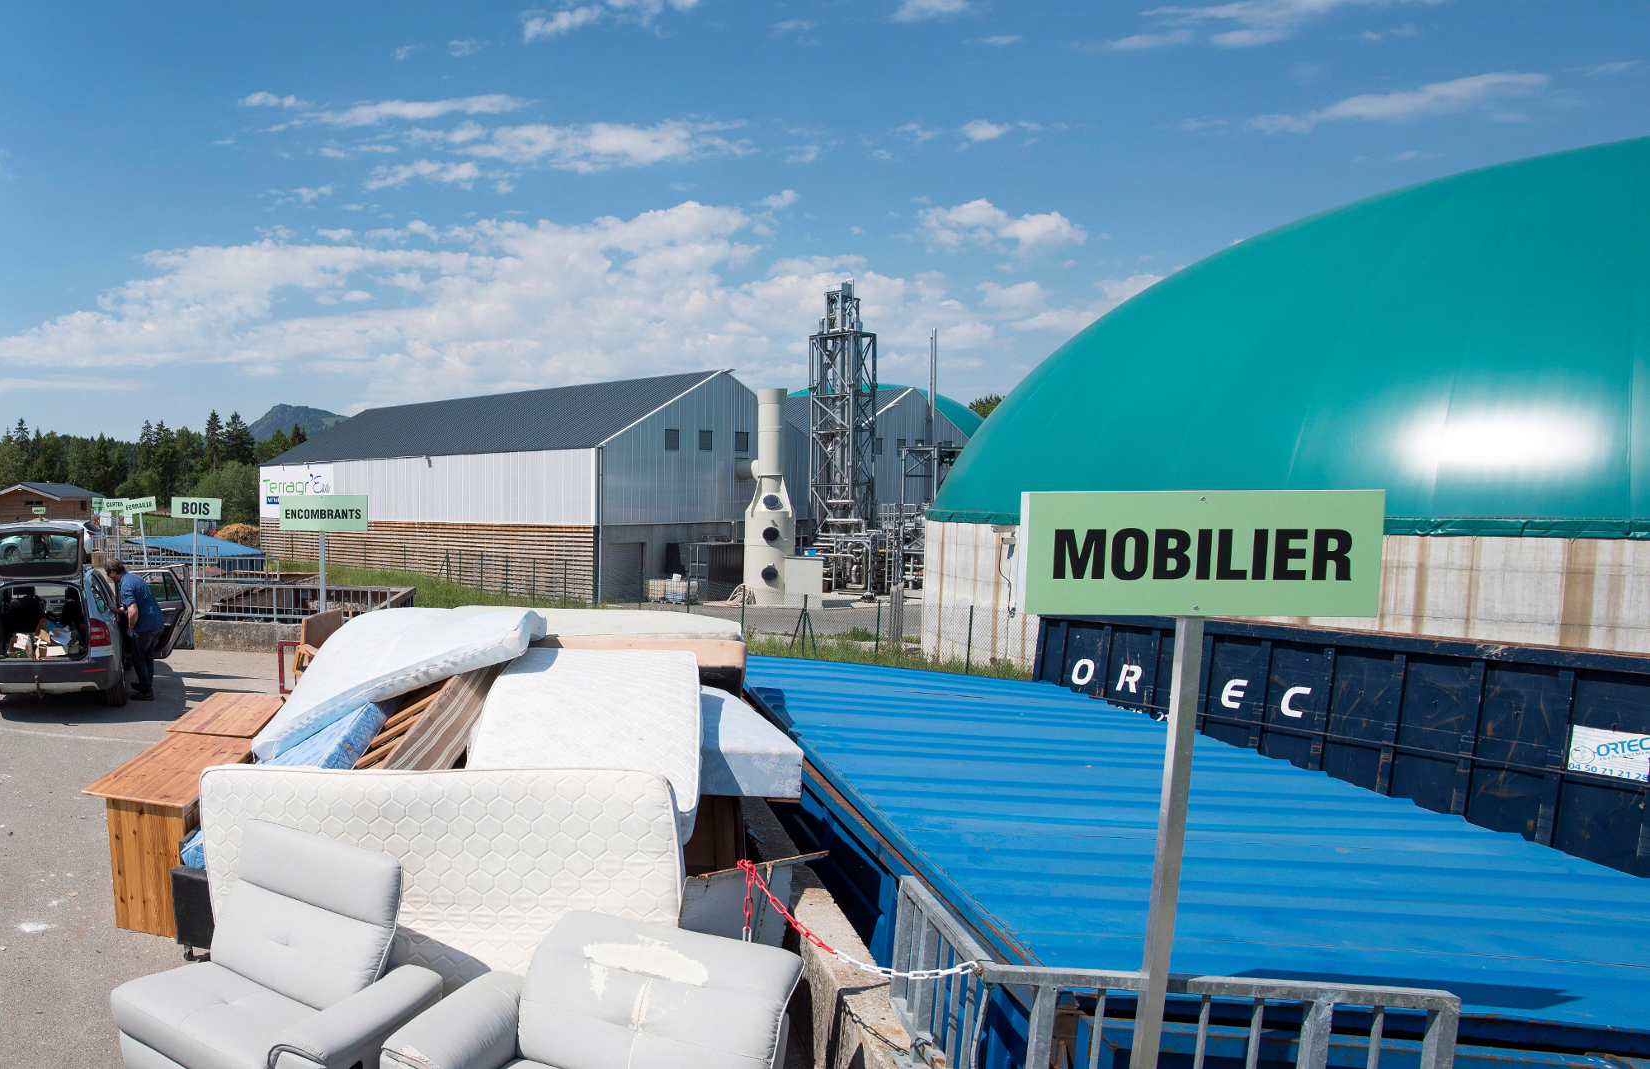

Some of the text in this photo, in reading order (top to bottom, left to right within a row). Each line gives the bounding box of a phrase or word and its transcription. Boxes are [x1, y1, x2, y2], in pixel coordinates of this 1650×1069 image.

[181, 502, 210, 515] BOIS
[285, 509, 361, 519] ENCOMBRANTS
[1052, 528, 1353, 580] MOBILIER
[1071, 659, 1312, 718] OREC
[1597, 737, 1650, 757] ORTEC
[1569, 762, 1581, 770] 04
[1585, 765, 1597, 773] 50
[1601, 767, 1613, 776] 71
[1618, 770, 1631, 778] 21
[1635, 773, 1649, 781] 28
